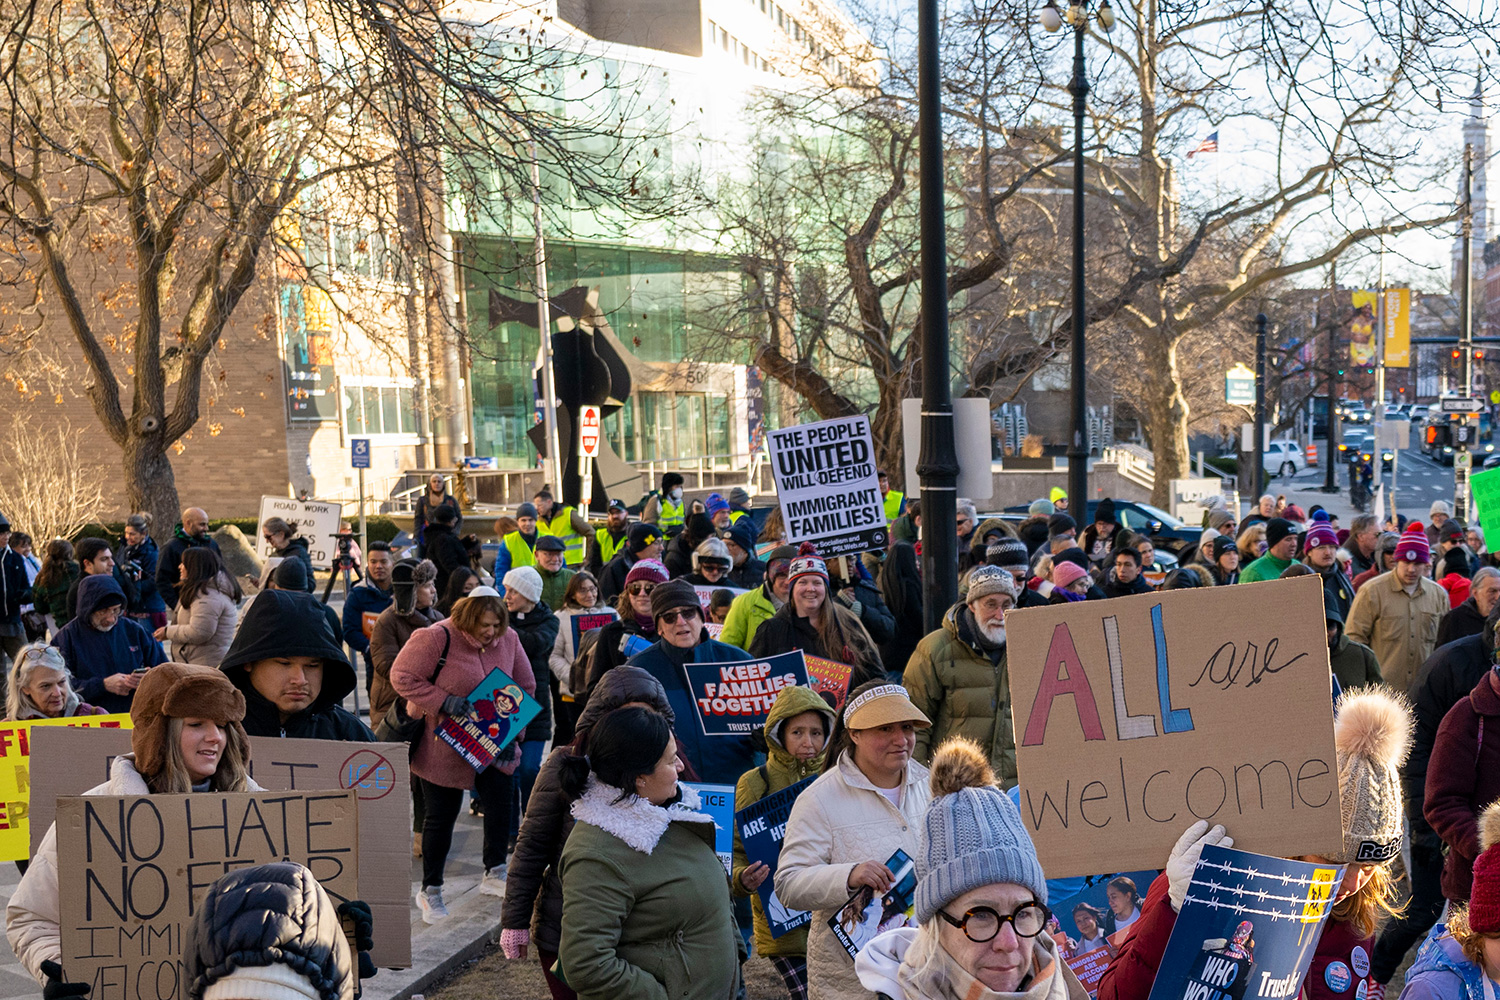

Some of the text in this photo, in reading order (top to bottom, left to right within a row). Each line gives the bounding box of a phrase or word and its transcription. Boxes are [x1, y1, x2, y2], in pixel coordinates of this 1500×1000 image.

[773, 422, 867, 450] THE PEOPLE
[777, 439, 869, 477] UNITED
[781, 463, 872, 491] WILL DEFEND
[273, 502, 329, 514] ROAD WORK
[787, 488, 877, 518] IMMIGRANT
[790, 505, 881, 538] FAMILIES!
[704, 673, 798, 699] FAMILIES
[720, 662, 772, 683] KEEP
[1021, 602, 1309, 747] ALL are
[464, 723, 483, 740] ONE
[478, 735, 502, 758] MORE
[727, 723, 751, 732] TRUST
[439, 729, 456, 746] Trust
[465, 753, 483, 769] NOW!
[440, 717, 494, 768] DEPORTATION
[705, 795, 726, 807] ICE
[1025, 757, 1333, 832] welcome
[85, 798, 164, 863] NO
[185, 794, 351, 859] HATE
[742, 816, 768, 839] ARE
[86, 862, 169, 922] NO
[783, 917, 803, 932] Trust
[833, 924, 850, 949] Greater
[1084, 961, 1098, 972] ARE
[1199, 955, 1240, 990] WHO
[1257, 971, 1290, 998] Trust
